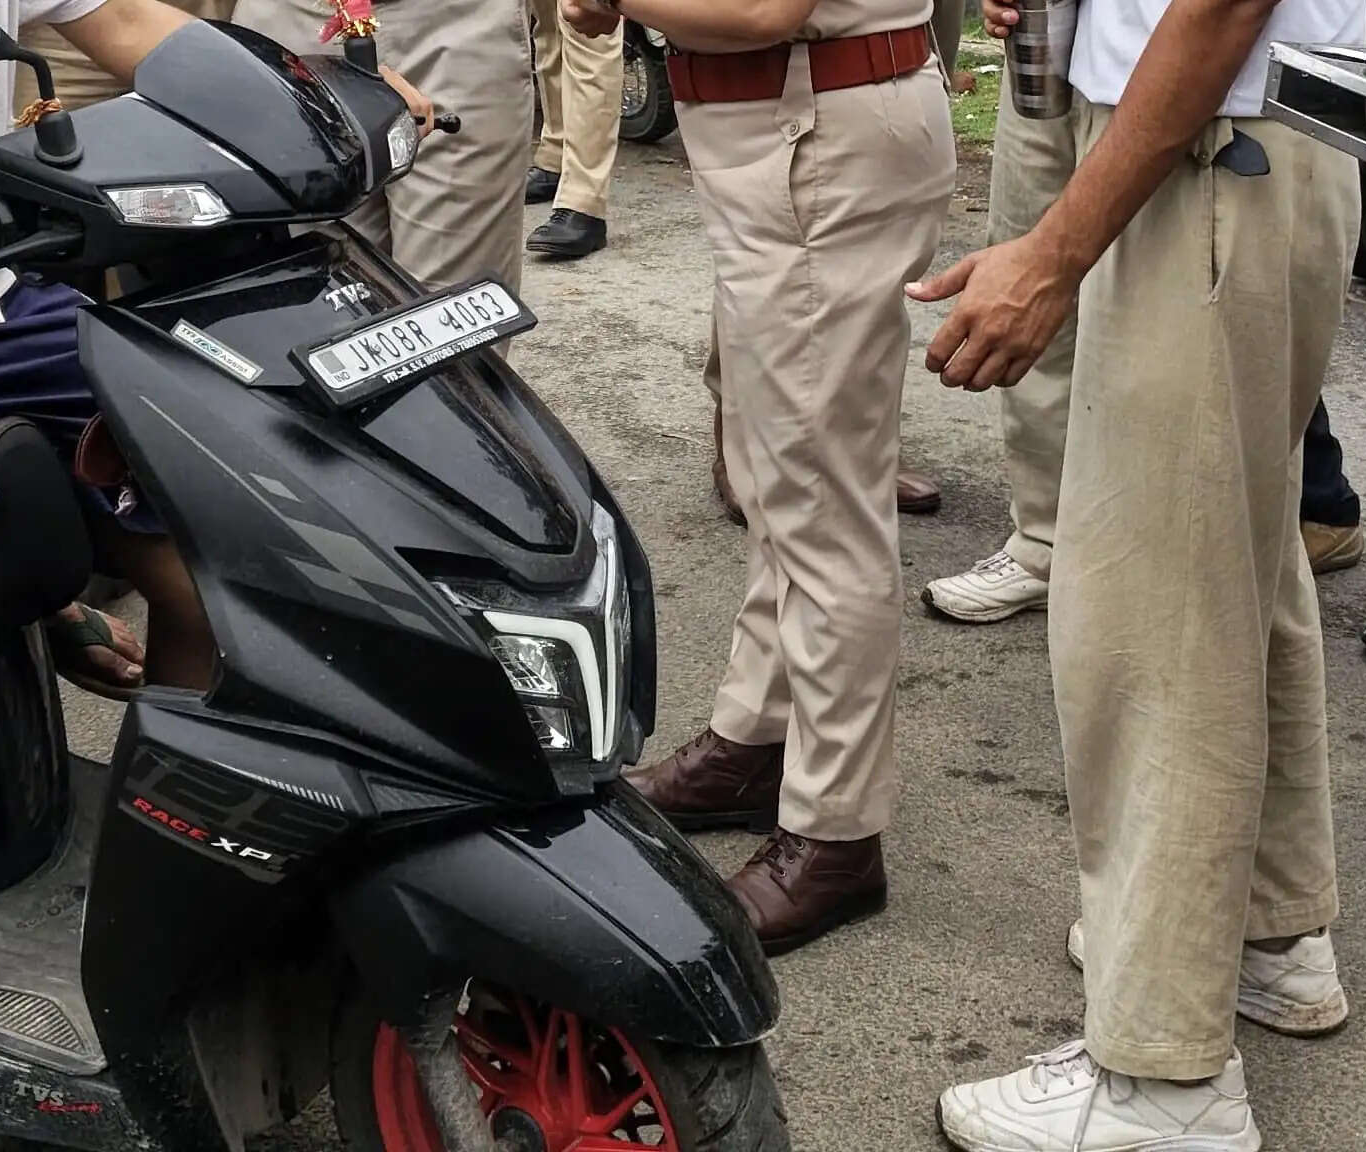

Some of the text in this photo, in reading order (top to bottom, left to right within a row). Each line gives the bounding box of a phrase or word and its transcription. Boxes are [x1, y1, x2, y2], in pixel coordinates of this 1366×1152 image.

[325, 282, 371, 311] TVS
[348, 319, 432, 372] JK08R
[441, 291, 505, 332] 4063
[133, 797, 272, 861] RACE XP
